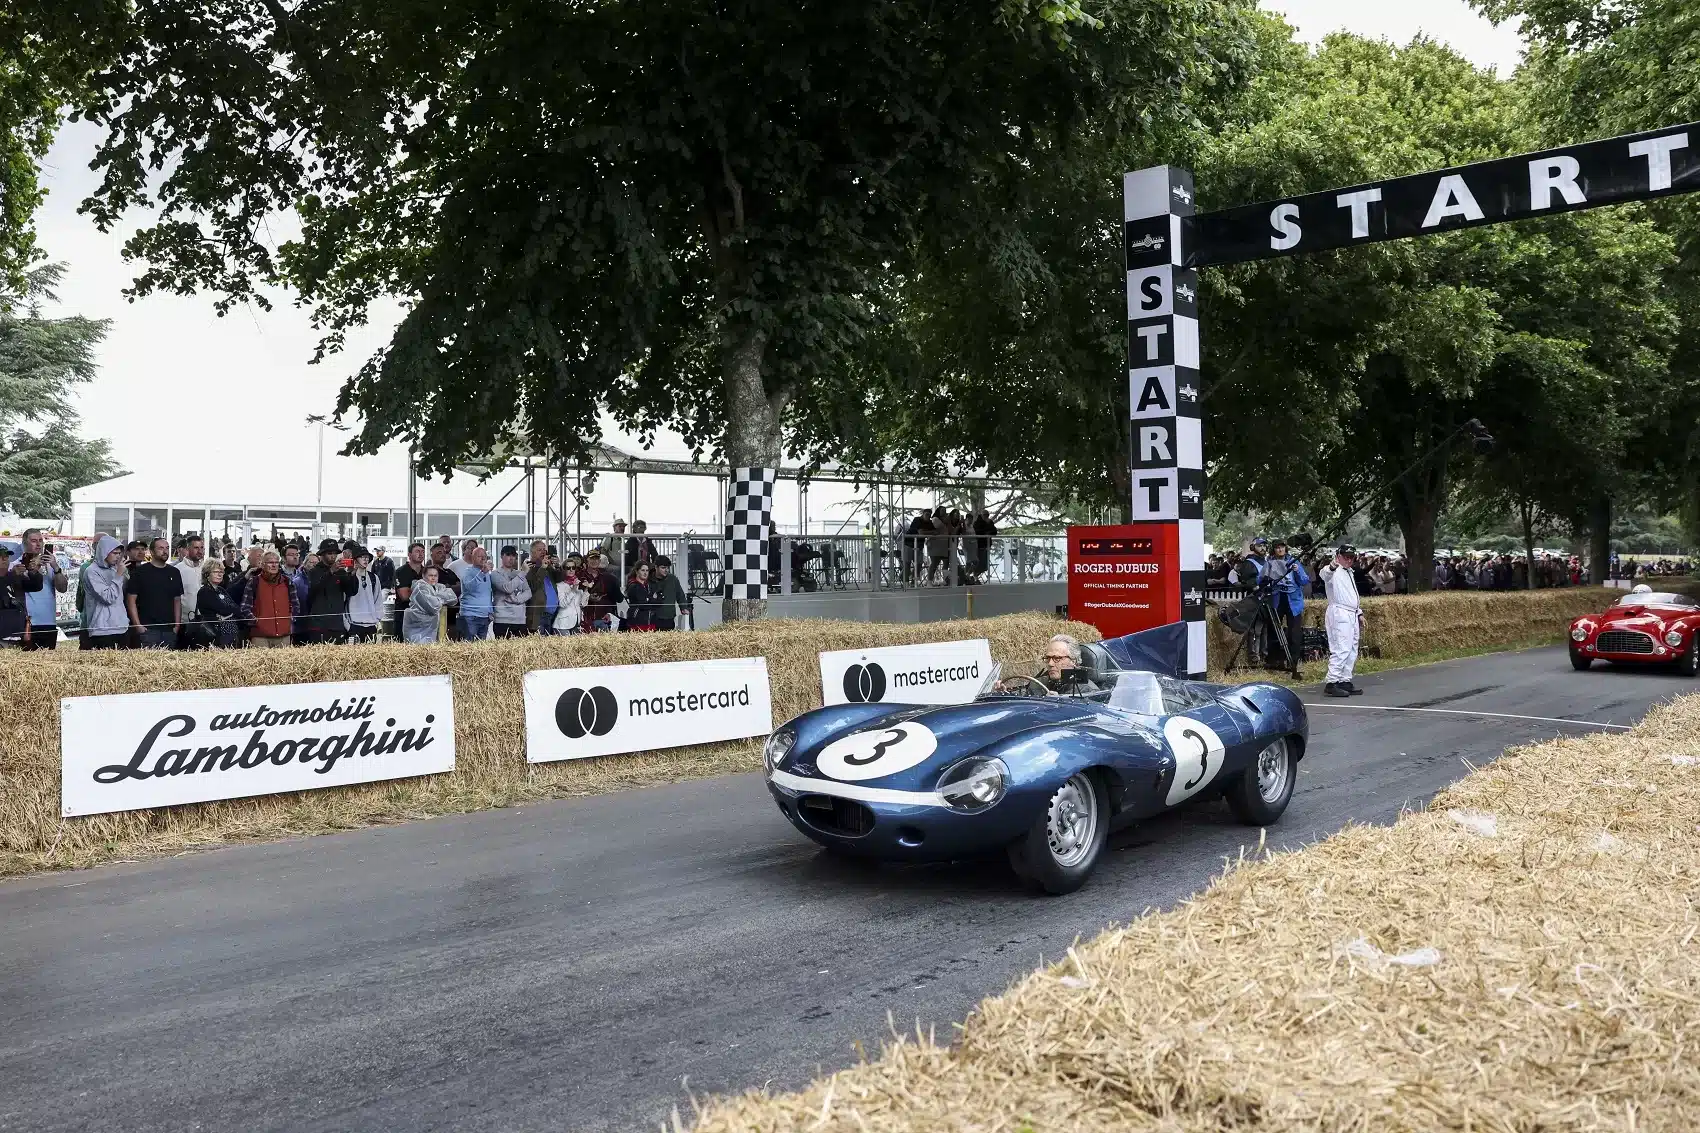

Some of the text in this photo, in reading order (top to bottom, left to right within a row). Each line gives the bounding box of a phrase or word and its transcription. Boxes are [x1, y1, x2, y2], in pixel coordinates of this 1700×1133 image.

[1270, 133, 1689, 250] START
[1136, 276, 1173, 512] START
[1074, 563, 1159, 574] ROGER DUBUIS
[894, 660, 979, 688] mastercard
[210, 696, 375, 732] automobili
[629, 684, 749, 717] mastercard
[92, 714, 435, 784] Lamborghini
[843, 728, 908, 766] 3
[1182, 728, 1209, 790] 3
